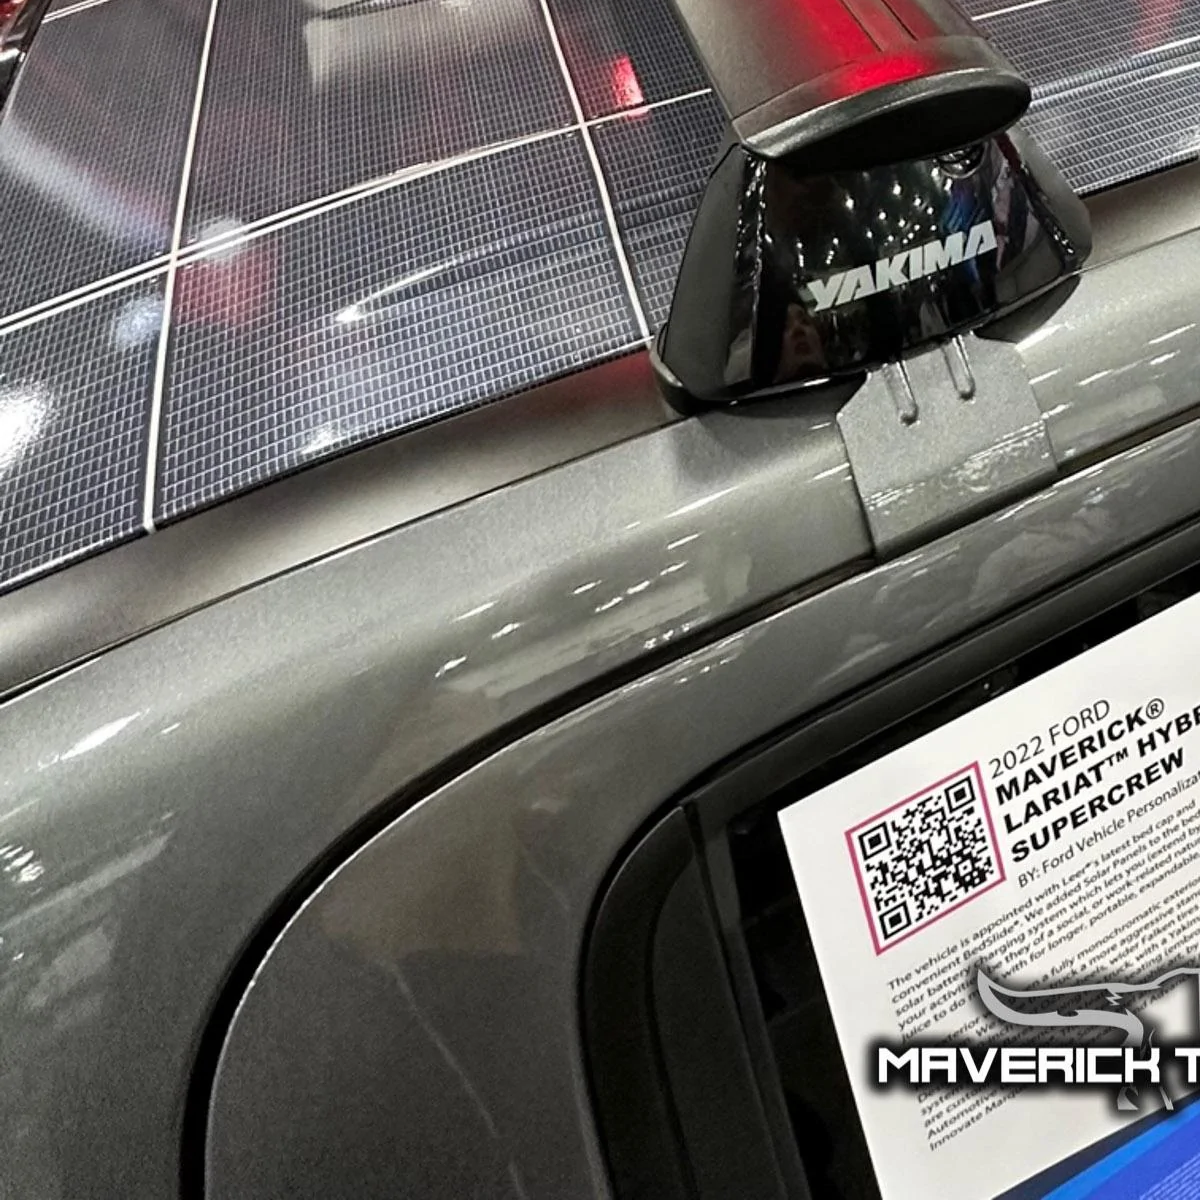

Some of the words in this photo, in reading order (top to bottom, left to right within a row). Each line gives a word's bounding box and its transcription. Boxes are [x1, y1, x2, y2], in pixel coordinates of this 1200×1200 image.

[807, 220, 998, 312] YAKIMA
[989, 736, 1044, 779] 2022
[1049, 700, 1109, 746] FORD
[1012, 748, 1182, 862] SUPERCREW
[1018, 867, 1040, 888] BY:
[1042, 845, 1074, 874] Ford
[1076, 819, 1124, 852] Vehicle
[888, 973, 911, 990] The
[915, 945, 957, 974] vehicle
[973, 898, 1032, 941] appointed
[1035, 884, 1060, 902] with
[1101, 840, 1131, 862] latest
[1132, 825, 1153, 843] bed
[1155, 815, 1174, 829] cap
[1176, 799, 1195, 817] and
[892, 957, 960, 1003] convenient
[1046, 882, 1081, 910] added
[1083, 866, 1110, 887] Solar
[1112, 844, 1147, 869] Panels
[1162, 825, 1179, 839] the
